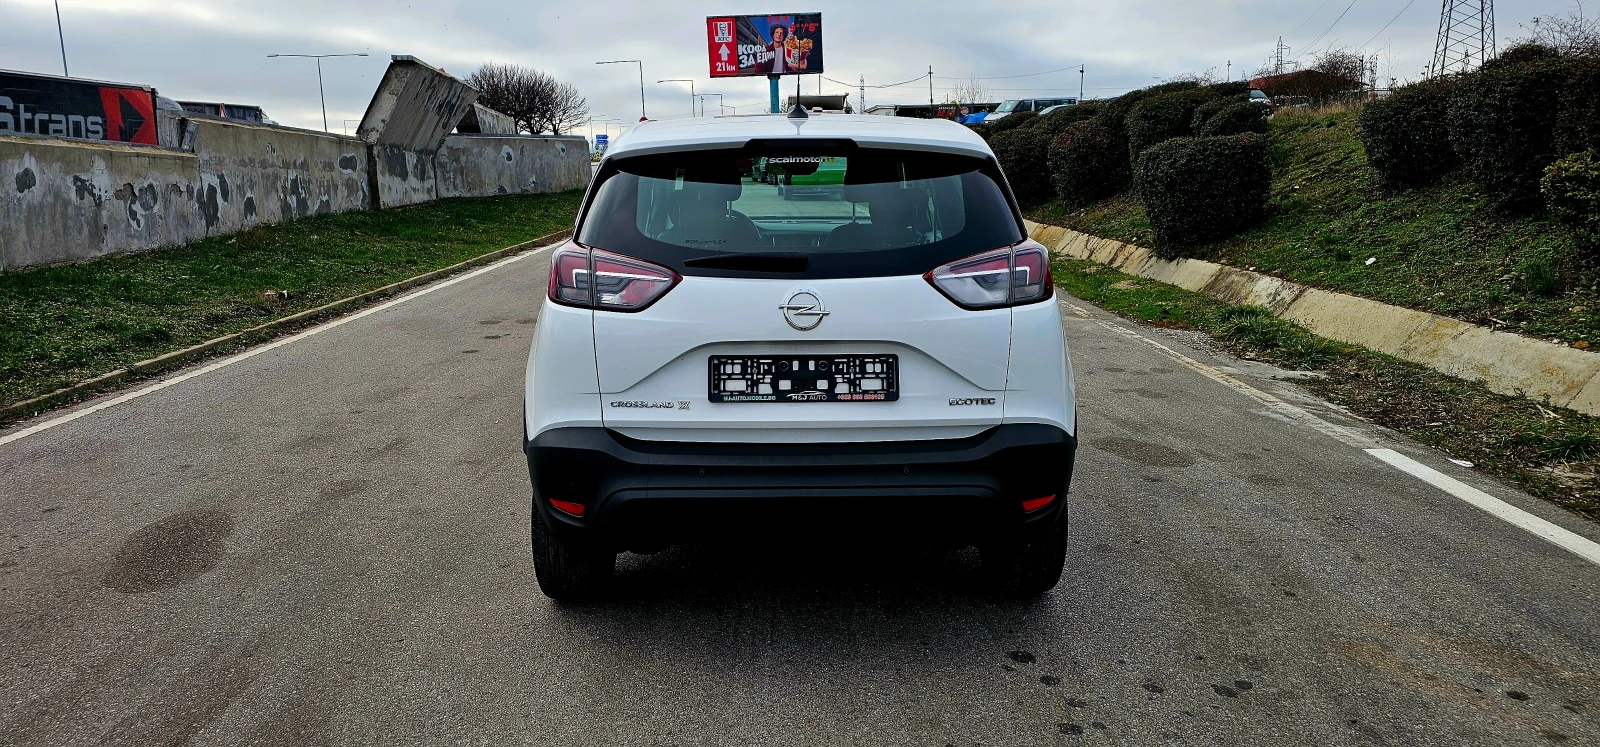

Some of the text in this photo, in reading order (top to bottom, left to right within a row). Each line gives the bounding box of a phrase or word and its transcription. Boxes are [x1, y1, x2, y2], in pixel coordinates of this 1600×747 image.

[737, 44, 767, 55] КОФА
[738, 51, 775, 68] ЗА ЕДИН
[716, 61, 726, 72] 21
[610, 400, 691, 410] CROSSLAND X
[949, 397, 996, 406] ECOTEC
